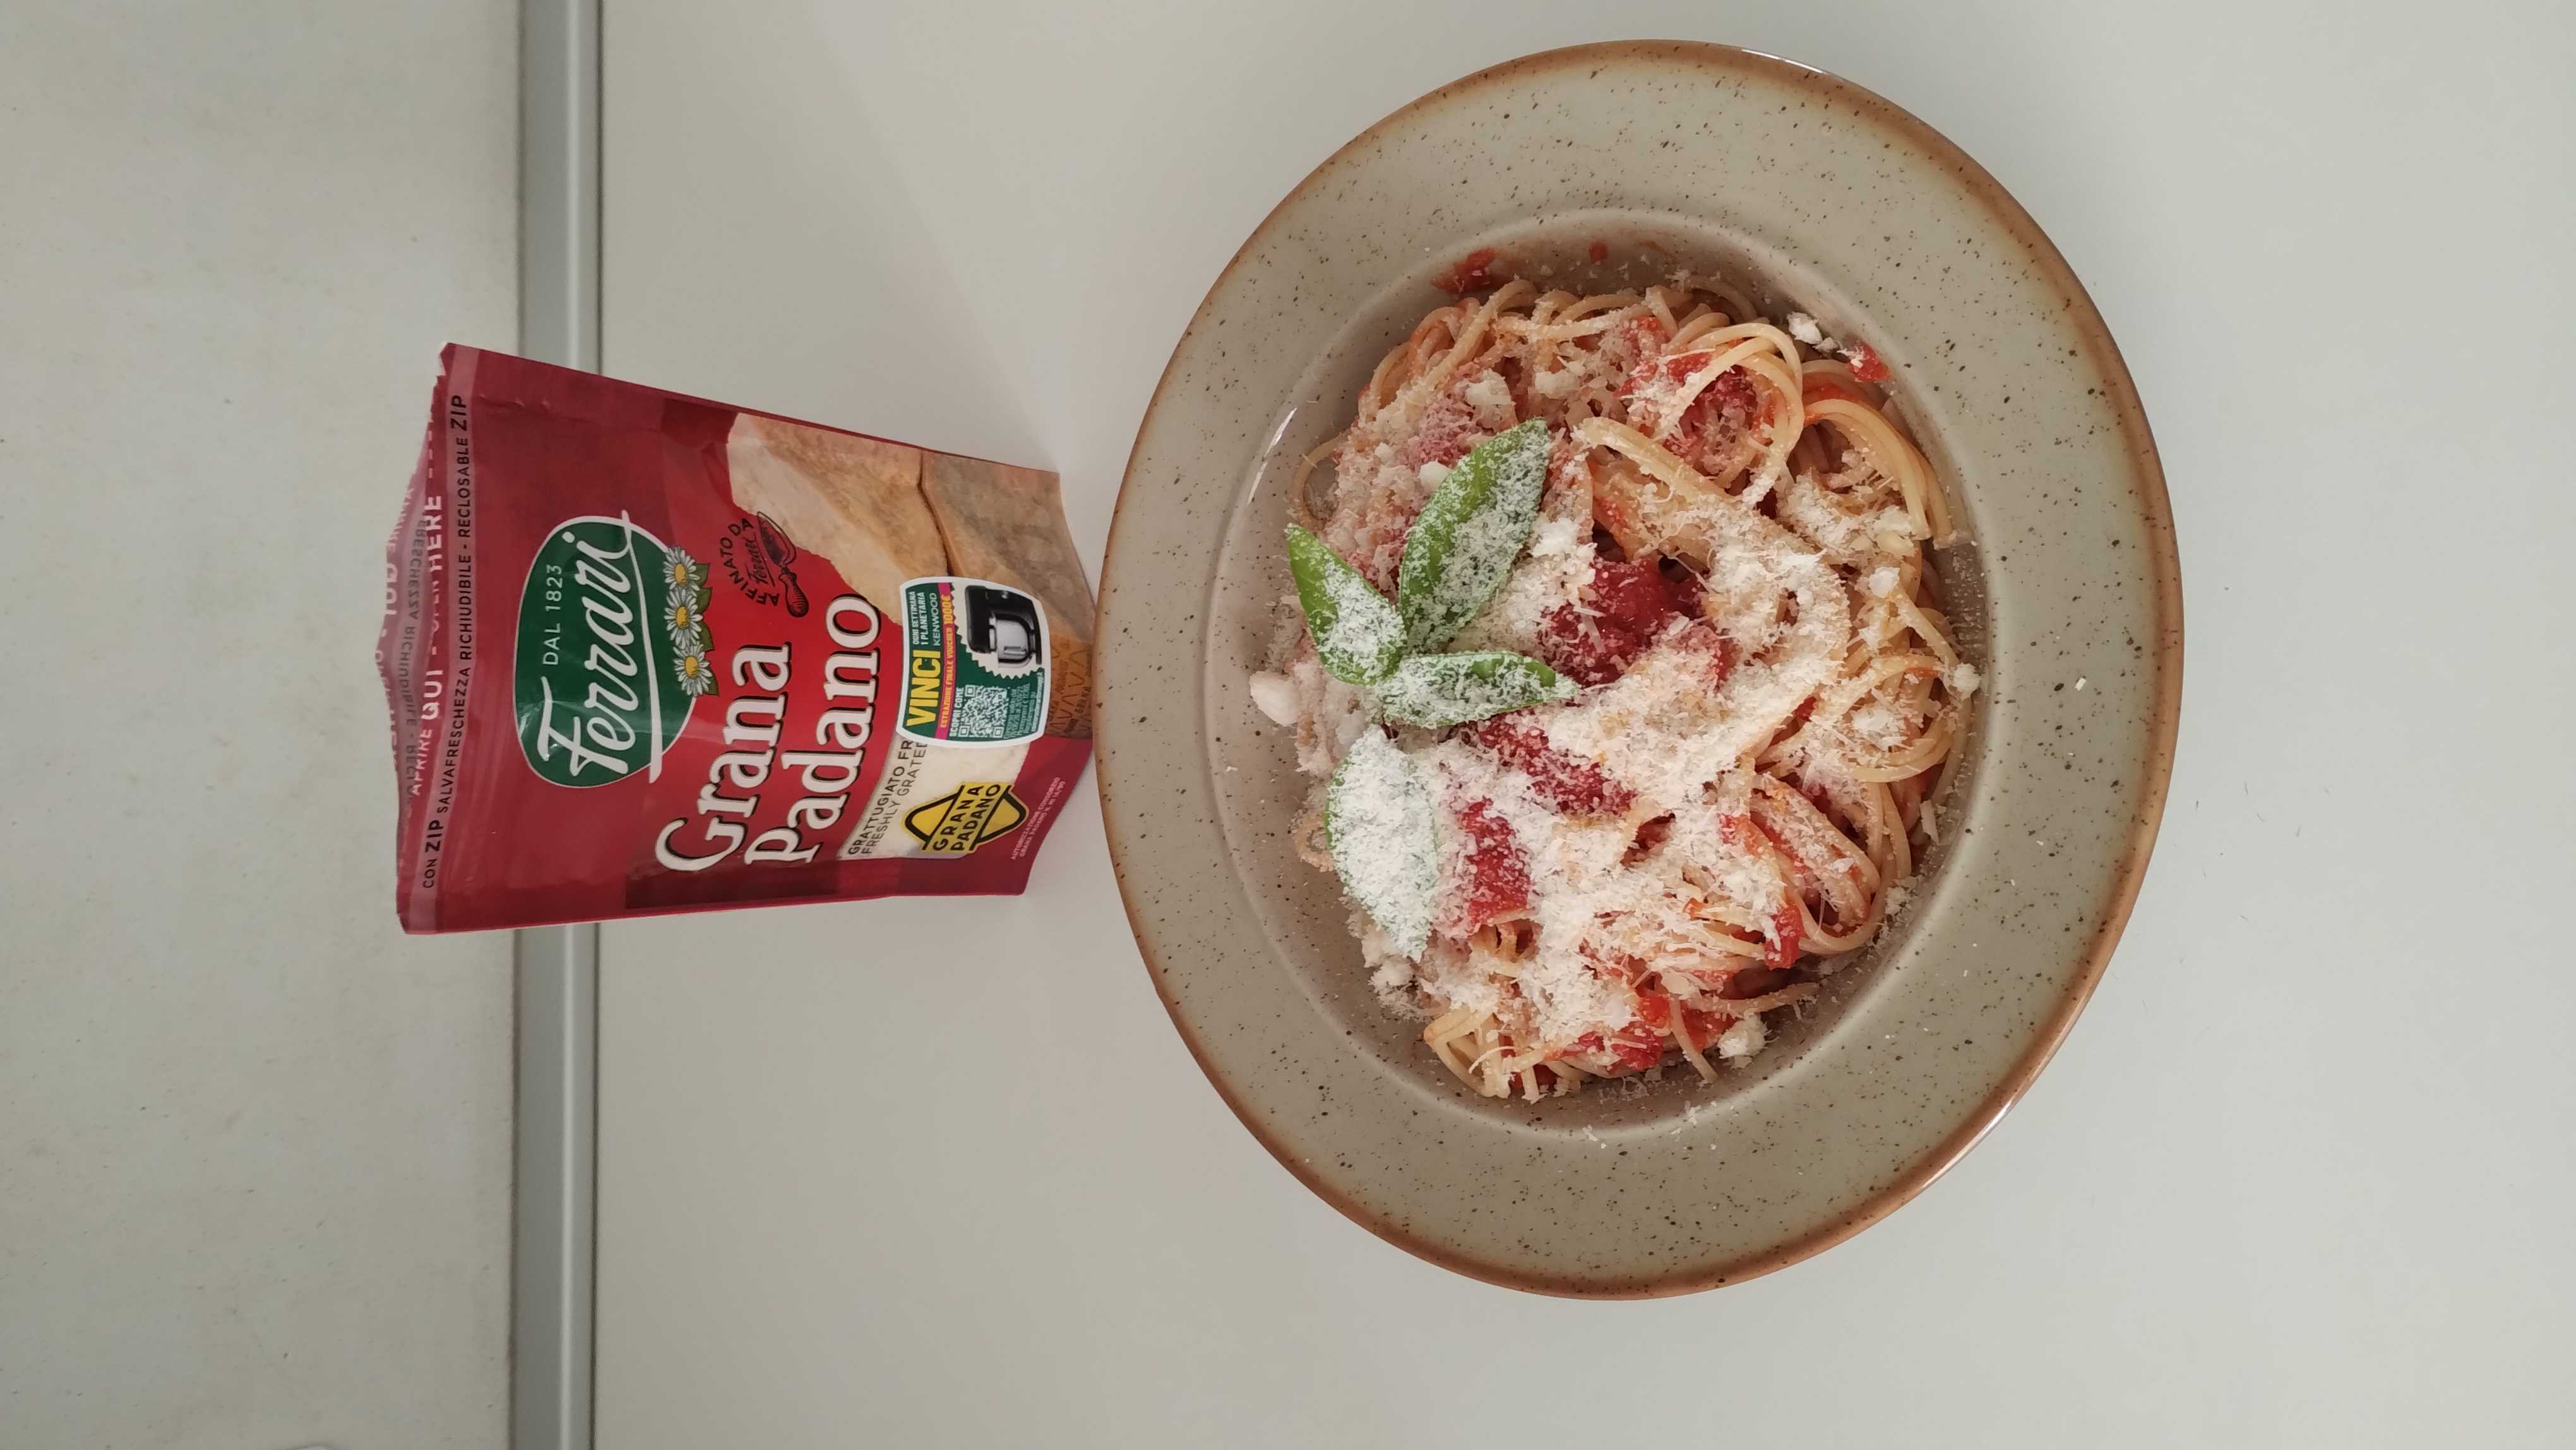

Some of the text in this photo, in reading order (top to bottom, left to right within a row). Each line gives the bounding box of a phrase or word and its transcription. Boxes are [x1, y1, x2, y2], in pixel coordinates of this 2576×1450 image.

[450, 394, 468, 431] ZIP
[455, 438, 470, 538] RECLOSABLE
[424, 496, 443, 572] HERE
[720, 517, 780, 606] AFFINATO DA
[742, 532, 775, 587] Ferrari
[458, 556, 472, 660] RICHIUDIBILE
[542, 564, 563, 666] DAL 1823
[909, 591, 920, 645] OGNI SETTIMANA
[917, 592, 929, 640] PLANETARIA
[929, 592, 941, 646] KENWOOD
[941, 594, 953, 625] 1000€
[537, 512, 658, 782] Ferrari
[420, 669, 443, 720] QUI
[906, 650, 941, 727] VINCI
[940, 686, 952, 728] ESTRAZIONE
[949, 687, 964, 737] SCOPRI COME
[436, 667, 472, 813] SALVAFRESCHEZZA
[655, 642, 792, 872] Grana
[743, 594, 880, 865] Padano
[424, 820, 443, 852] ZIP
[848, 766, 905, 854] GRATTUGIATO
[861, 801, 901, 854] FRESHLY
[933, 785, 984, 851] GRANA
[950, 784, 1001, 851] PADANO
[1011, 777, 1061, 860] AUTORIZZAZIONE CONSORZIO
[422, 858, 438, 889] CON
[1019, 836, 1033, 857] GRANA
